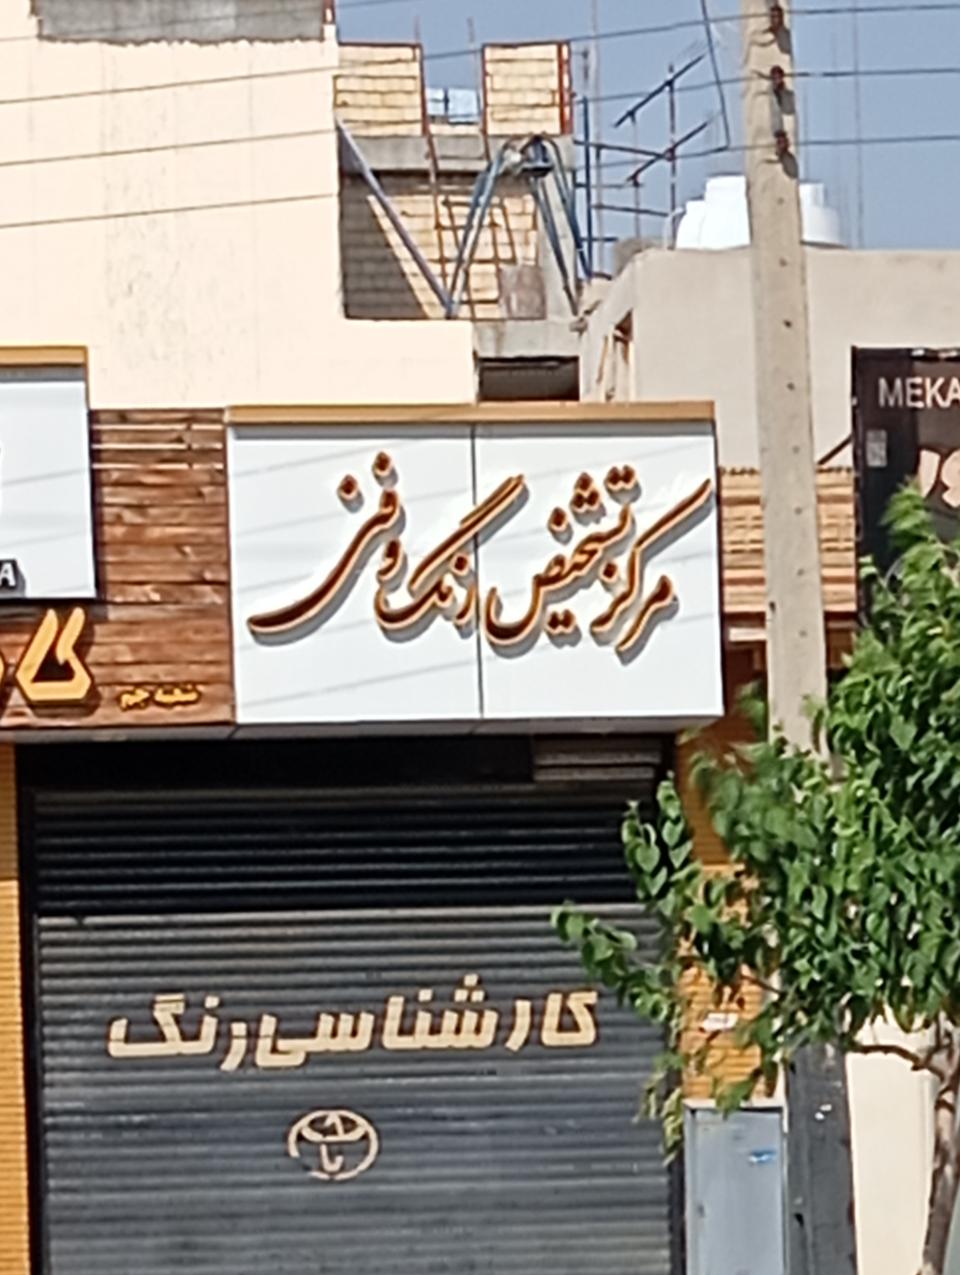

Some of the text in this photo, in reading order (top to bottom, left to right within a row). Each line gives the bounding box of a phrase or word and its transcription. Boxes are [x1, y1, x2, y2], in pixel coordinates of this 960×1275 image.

[247, 451, 712, 652] مرکز تشخیص رنگ و فنی
[0, 607, 91, 700] کا
[108, 973, 598, 1071] کارشناسی رنگ
